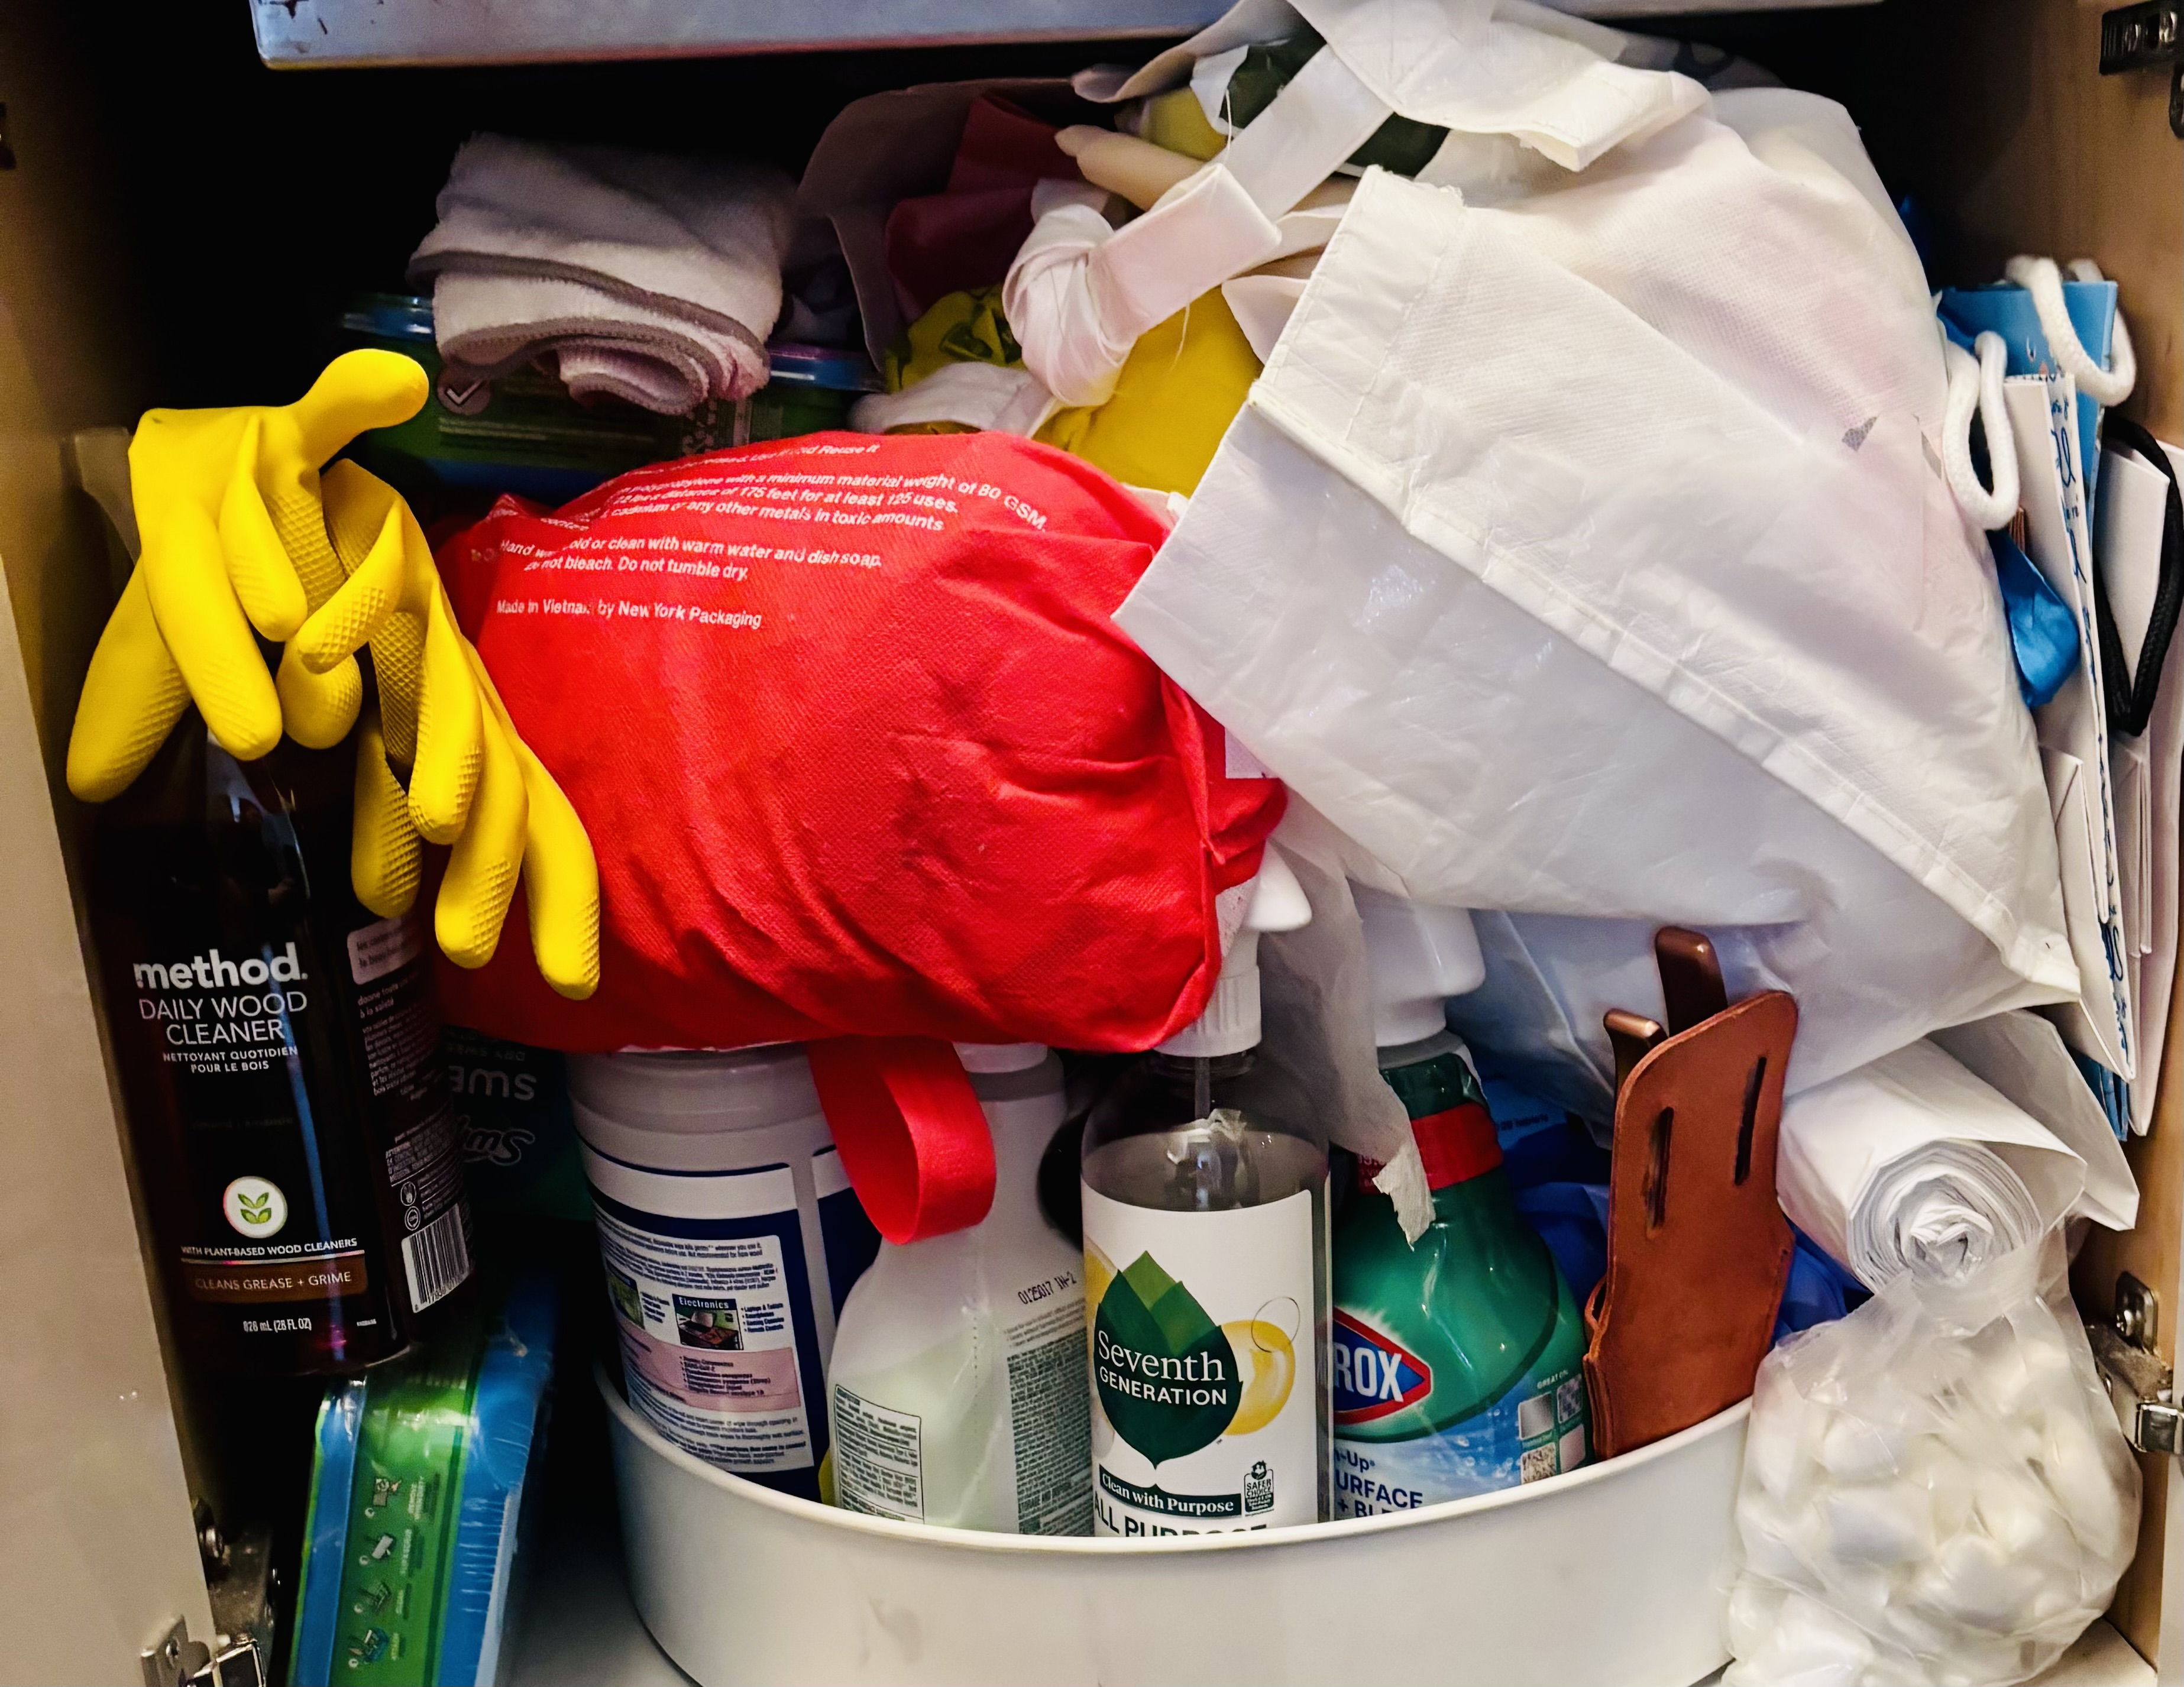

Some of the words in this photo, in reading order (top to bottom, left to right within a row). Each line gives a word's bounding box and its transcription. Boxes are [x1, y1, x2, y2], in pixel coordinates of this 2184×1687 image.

[818, 445, 866, 455] Reuse
[661, 488, 720, 500] distance
[720, 485, 739, 496] of
[739, 485, 767, 498] 175
[768, 487, 798, 502] feet
[798, 489, 823, 503] for
[823, 491, 841, 504] at
[842, 491, 885, 507] least
[886, 491, 914, 507] 125
[913, 494, 959, 513] uses.
[725, 474, 756, 484] with
[768, 472, 836, 485] minimum
[837, 474, 904, 488] material
[957, 483, 977, 496] of
[1003, 494, 1048, 532] GSM.
[685, 500, 714, 514] any
[715, 500, 759, 517] other
[758, 506, 812, 522] metals
[814, 507, 829, 522] in
[831, 510, 872, 527] toxic
[872, 511, 946, 532] amounts
[500, 539, 536, 557] Hand
[591, 537, 607, 550] or
[607, 536, 646, 551] clean
[648, 536, 680, 551] with
[682, 541, 724, 555] warm
[727, 543, 774, 559] water
[774, 548, 805, 562] and
[807, 549, 840, 565] dish
[840, 553, 882, 570] soap.
[541, 555, 564, 570] not
[564, 555, 613, 572] bleach.
[617, 556, 638, 572] Do
[641, 558, 665, 572] not
[666, 558, 720, 579] tumble
[722, 562, 748, 582] dry.
[496, 599, 525, 614] Made
[527, 599, 539, 614] in
[597, 598, 615, 620] by
[617, 600, 650, 619] New
[653, 602, 687, 621] York
[688, 605, 762, 630] Packaging
[138, 998, 204, 1021] DAILY
[211, 990, 308, 1019] WOOD
[166, 1018, 286, 1045] CLEANER
[161, 1051, 227, 1063] NETTOYANT
[229, 1045, 299, 1061] QUOTIDIEN
[190, 1061, 222, 1074] POUR
[225, 1061, 239, 1073] LE
[241, 1060, 270, 1072] BOIS
[180, 1245, 203, 1256] WITH
[203, 1245, 266, 1257] PLANT-BASED
[266, 1244, 303, 1256] WOOD
[303, 1237, 358, 1253] CLEANERS
[194, 1278, 241, 1291] CLEANS
[242, 1277, 294, 1290] GREASE
[297, 1277, 306, 1287] +
[308, 1271, 352, 1287] GRIME
[678, 1296, 730, 1310] Electronics
[1098, 1330, 1226, 1381] Seventh
[1099, 1365, 1227, 1406] GENERATION
[1101, 1472, 1130, 1500] Clean
[1132, 1490, 1164, 1510] with
[1166, 1497, 1235, 1516] Purpose
[1246, 1478, 1272, 1491] SAFER
